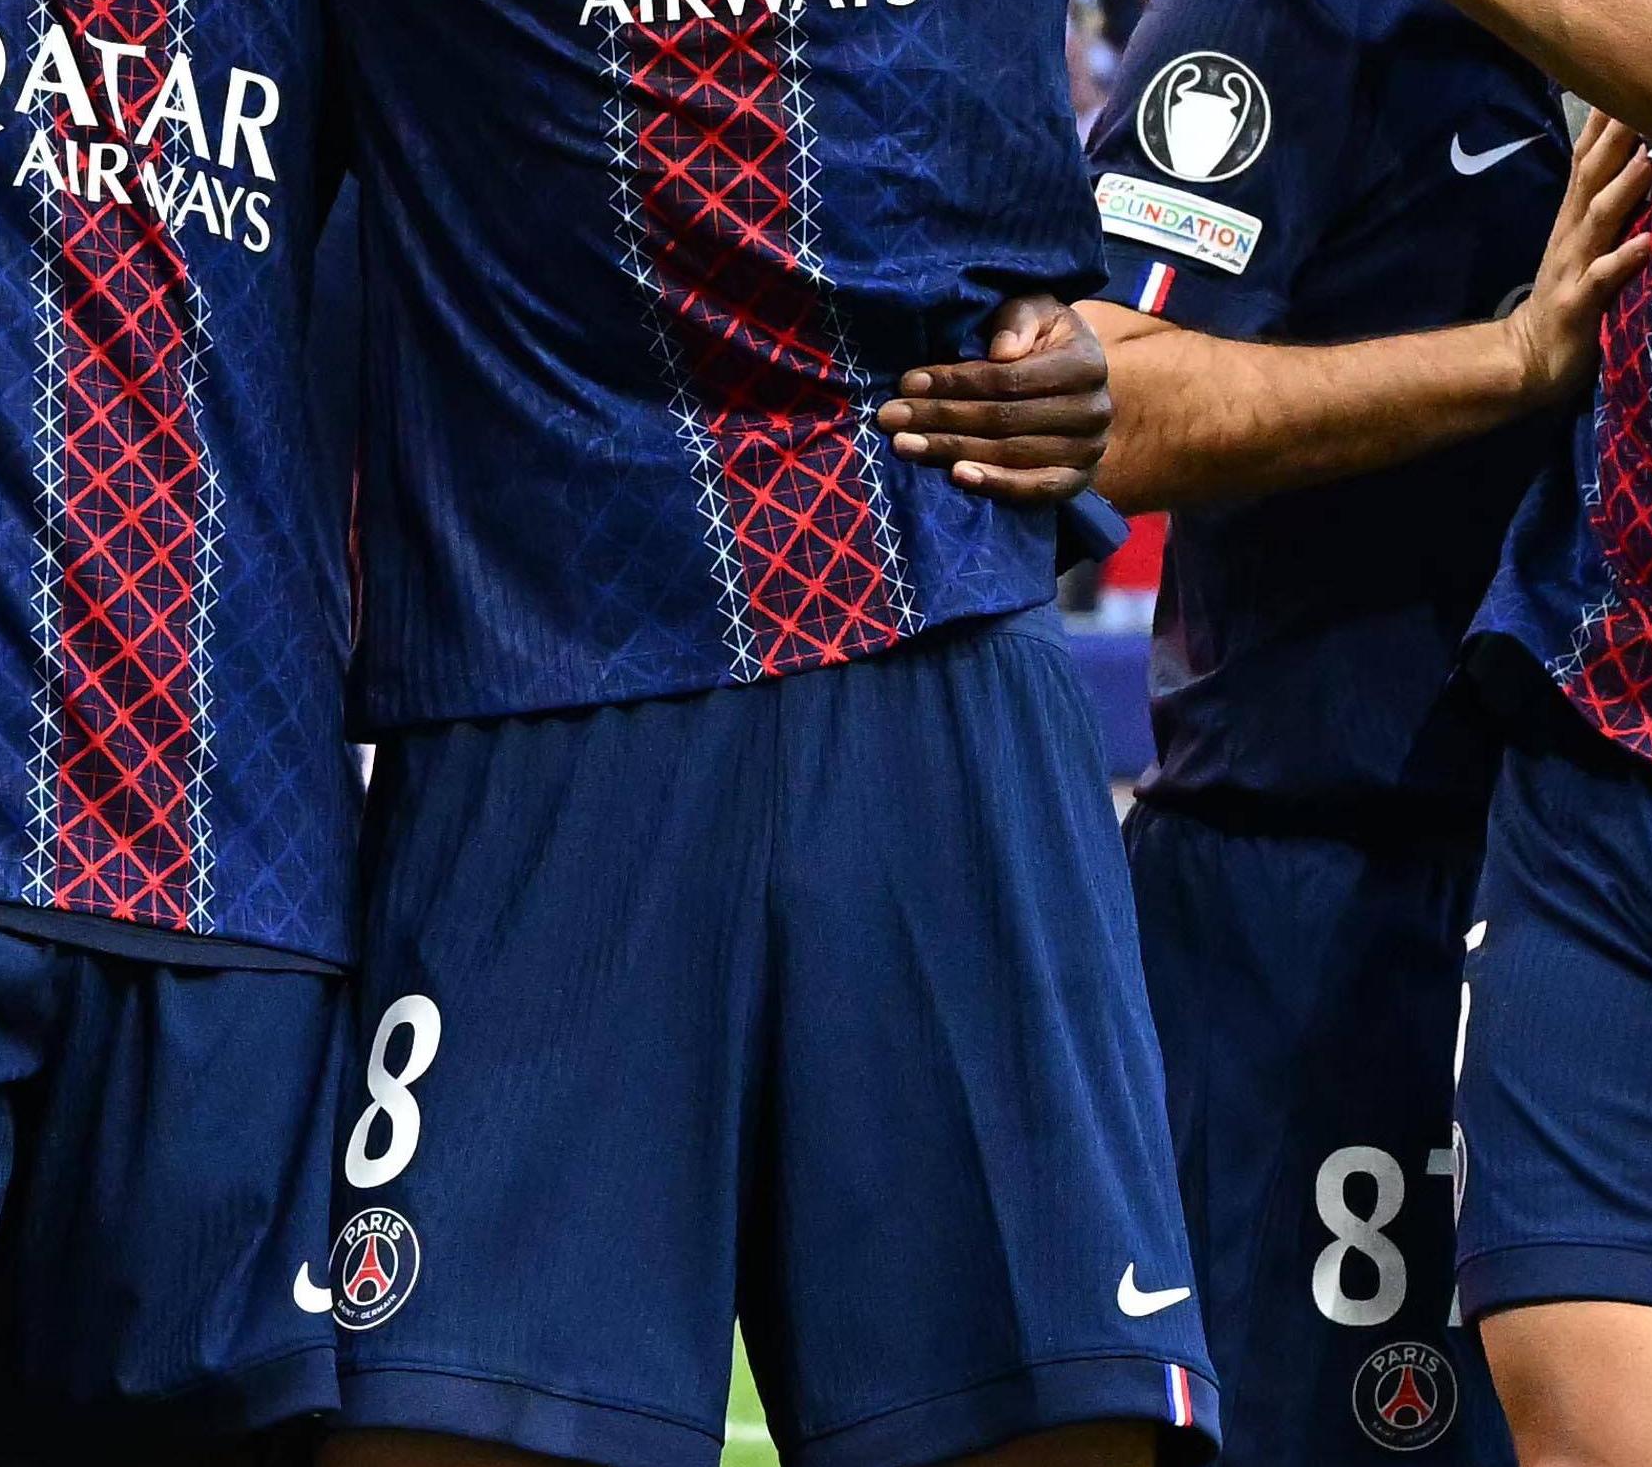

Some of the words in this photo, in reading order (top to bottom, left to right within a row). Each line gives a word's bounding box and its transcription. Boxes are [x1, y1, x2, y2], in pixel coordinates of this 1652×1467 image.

[12, 130, 272, 253] AIRWAYS
[1098, 192, 1252, 253] FOUNDATION
[345, 994, 441, 1188] 8
[344, 1213, 404, 1245] PARIS
[1372, 1347, 1440, 1373] PARIS
